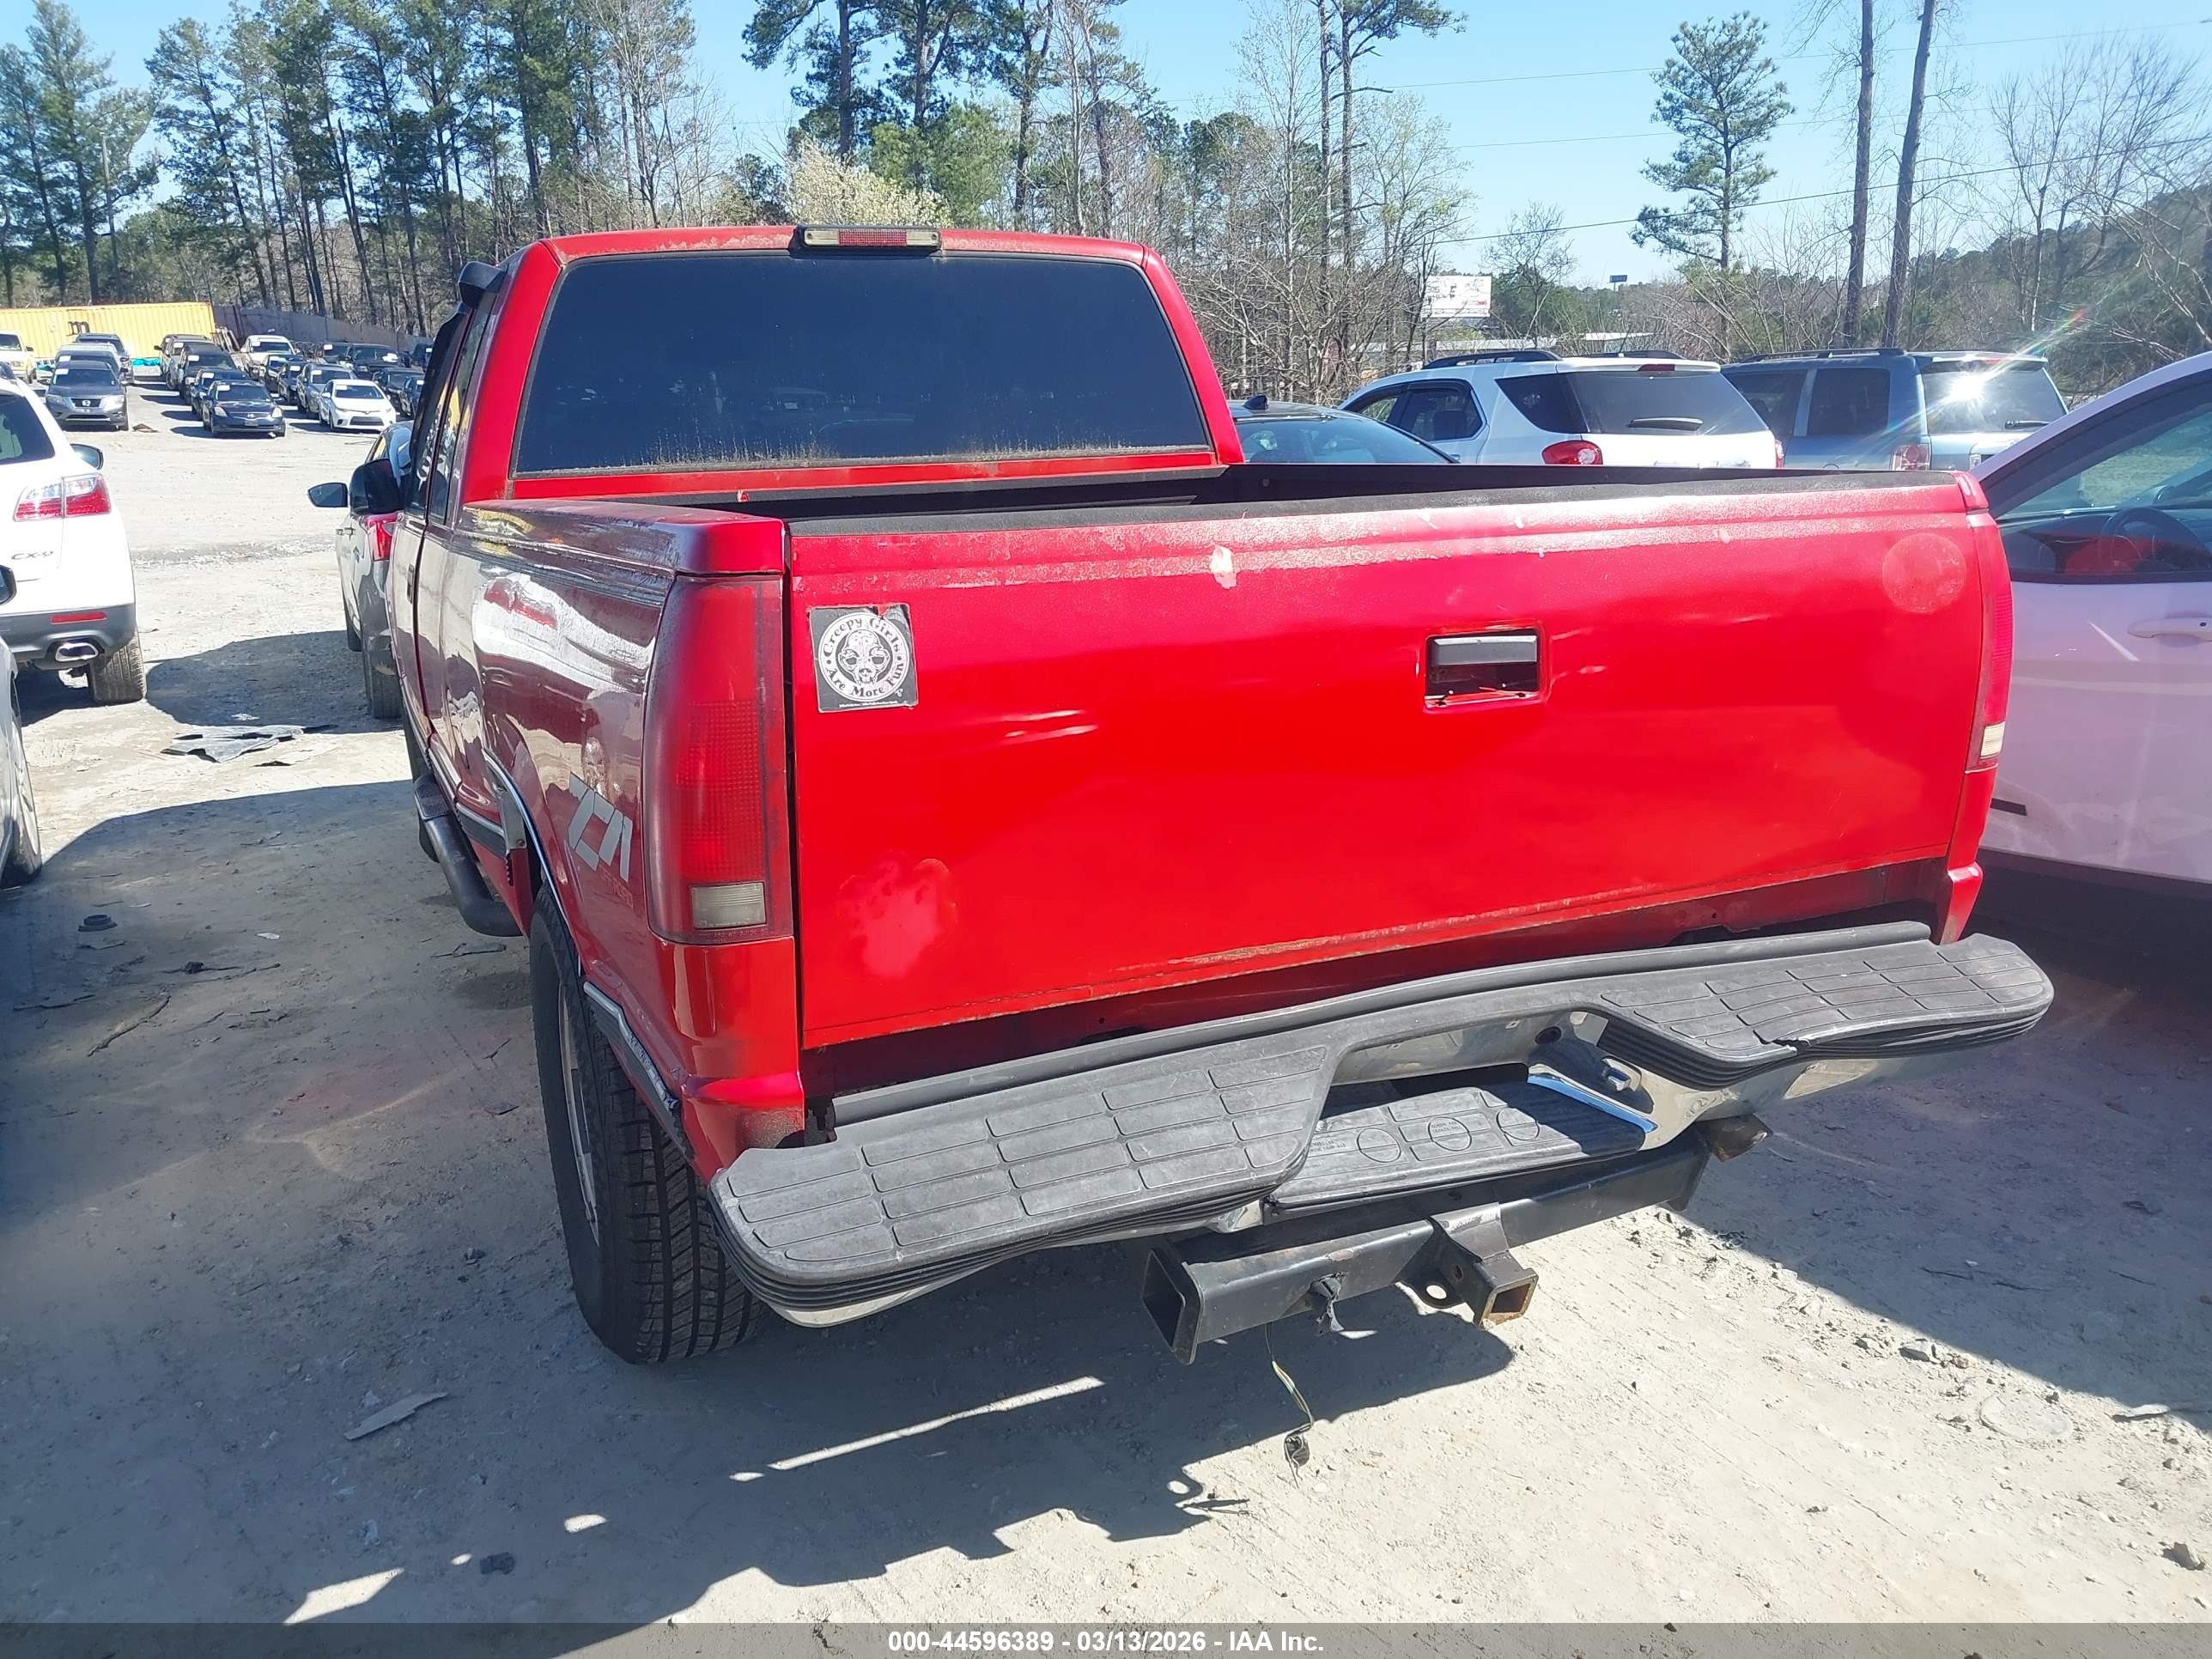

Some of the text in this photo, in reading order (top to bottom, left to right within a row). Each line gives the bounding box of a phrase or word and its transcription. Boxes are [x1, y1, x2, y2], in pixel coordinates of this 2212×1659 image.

[823, 617, 902, 658] Creepy Girls
[826, 667, 847, 690] Are
[850, 684, 885, 697] More
[887, 663, 905, 687] Fun
